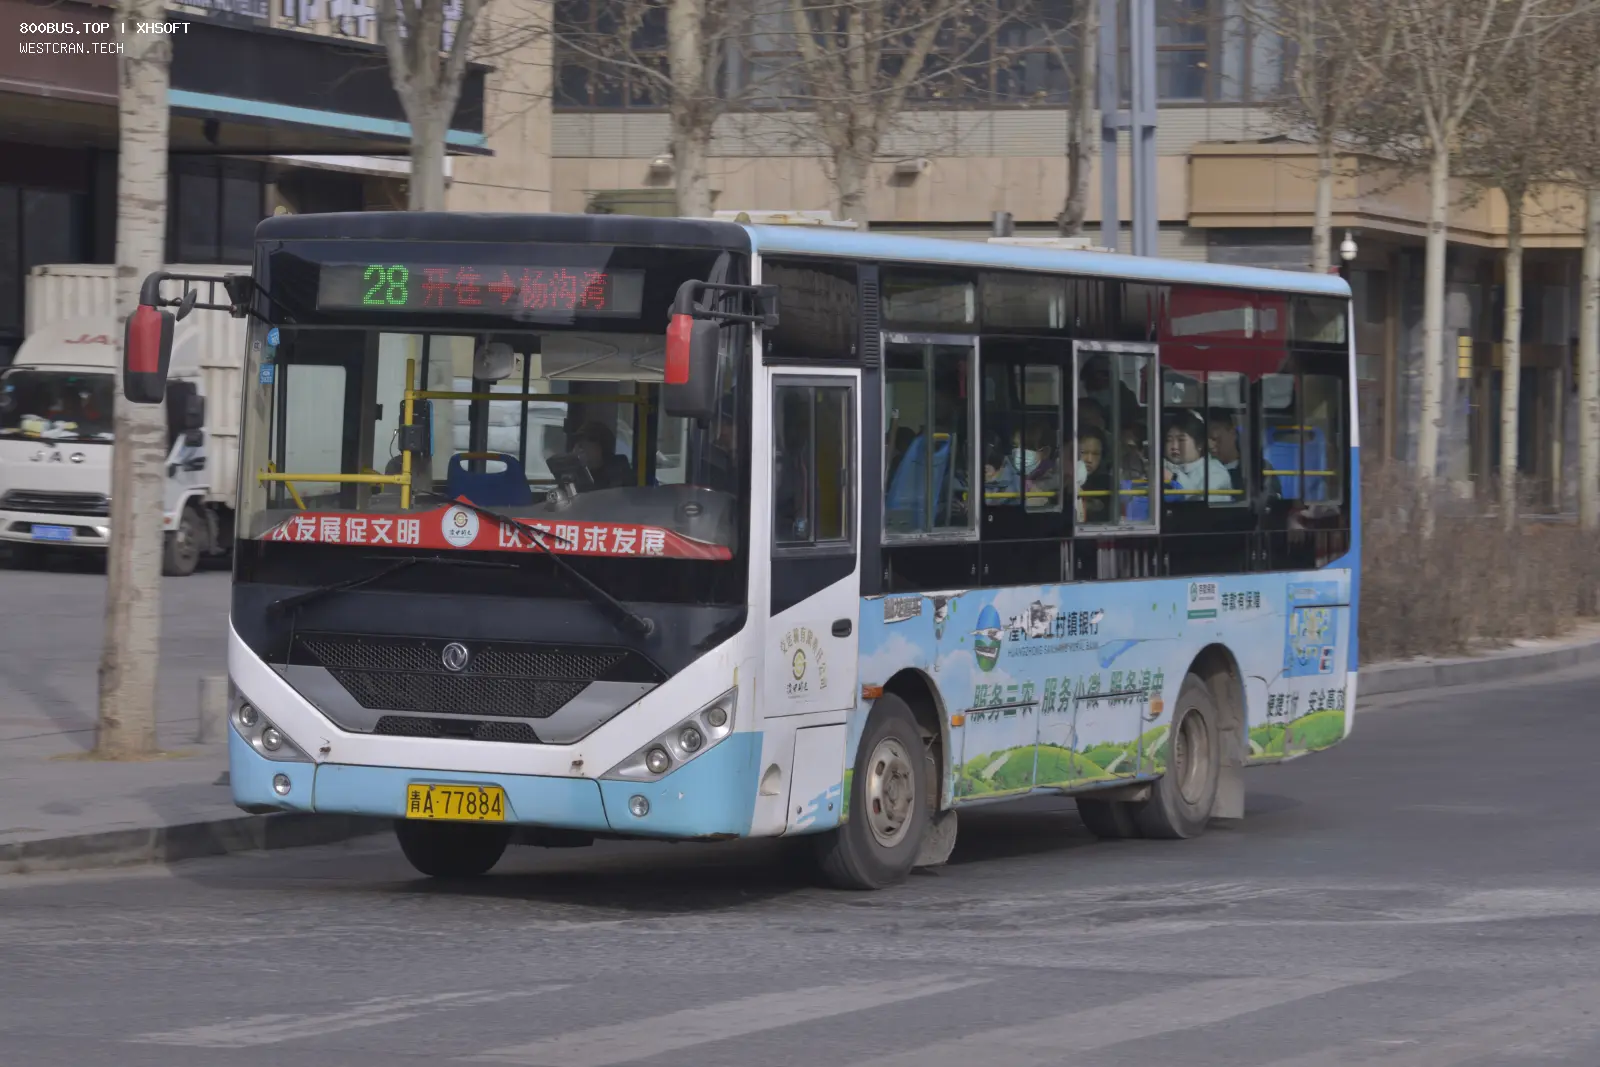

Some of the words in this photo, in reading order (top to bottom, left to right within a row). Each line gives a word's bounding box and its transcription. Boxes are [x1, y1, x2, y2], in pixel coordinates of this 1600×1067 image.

[363, 264, 409, 305] 28
[64, 333, 117, 346] JA
[29, 451, 86, 464] JAC
[499, 522, 666, 556] 以文明求发展
[971, 681, 1035, 722] 服务三农
[1042, 673, 1101, 714] 服务小微
